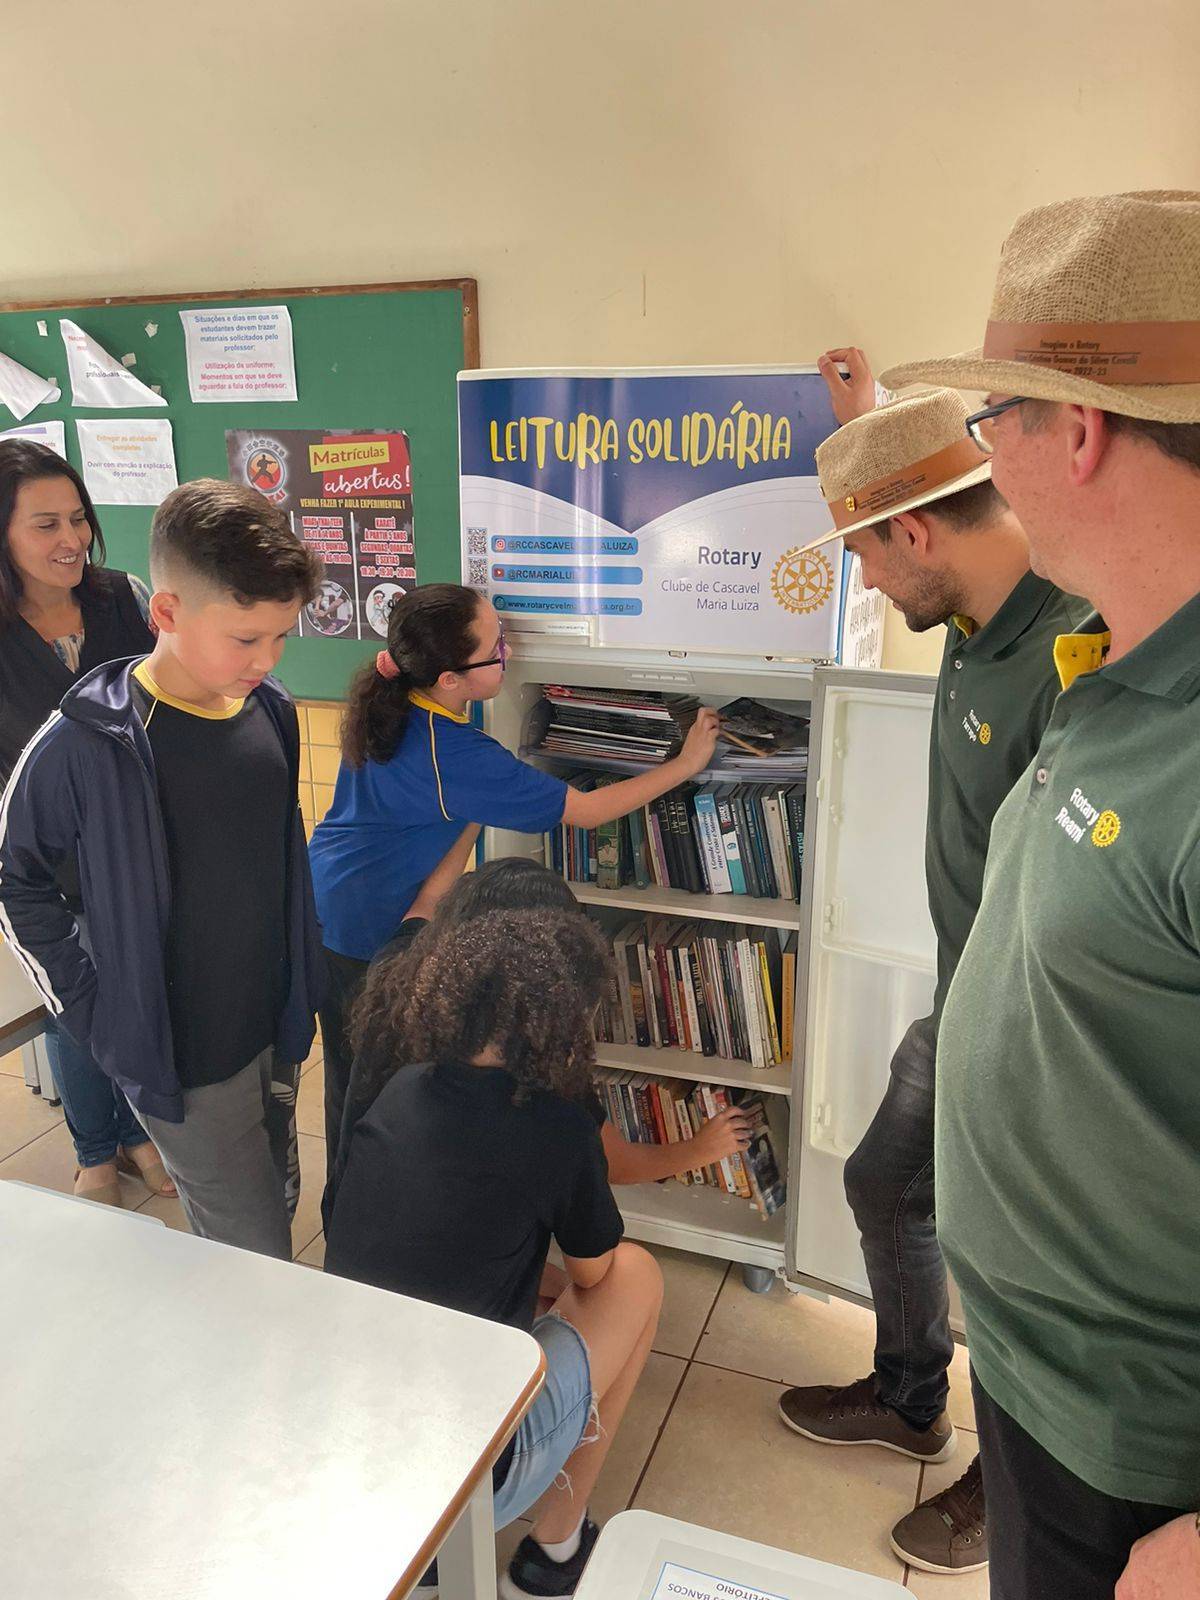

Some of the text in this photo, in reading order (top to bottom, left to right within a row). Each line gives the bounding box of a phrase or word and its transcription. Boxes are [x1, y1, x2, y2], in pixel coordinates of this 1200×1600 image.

[194, 315, 225, 323] Situações
[264, 334, 278, 342] pelo
[490, 400, 792, 470] LEITURA SOLIDÁRIA
[313, 446, 385, 466] Matrículas
[300, 498, 320, 508] VENHA
[320, 498, 337, 508] FAZER
[344, 499, 360, 508] AULA
[360, 500, 402, 509] EXPERIMENTAL
[369, 530, 388, 541] PARTIR
[392, 530, 408, 542] ANOS
[380, 554, 400, 566] SEXTAS
[698, 546, 762, 570] Rotary
[661, 580, 760, 594] Clube de Cascavel
[696, 598, 760, 611] Maria Luiza
[1070, 787, 1100, 826] Rotary
[667, 1582, 711, 1600] BANCOS
